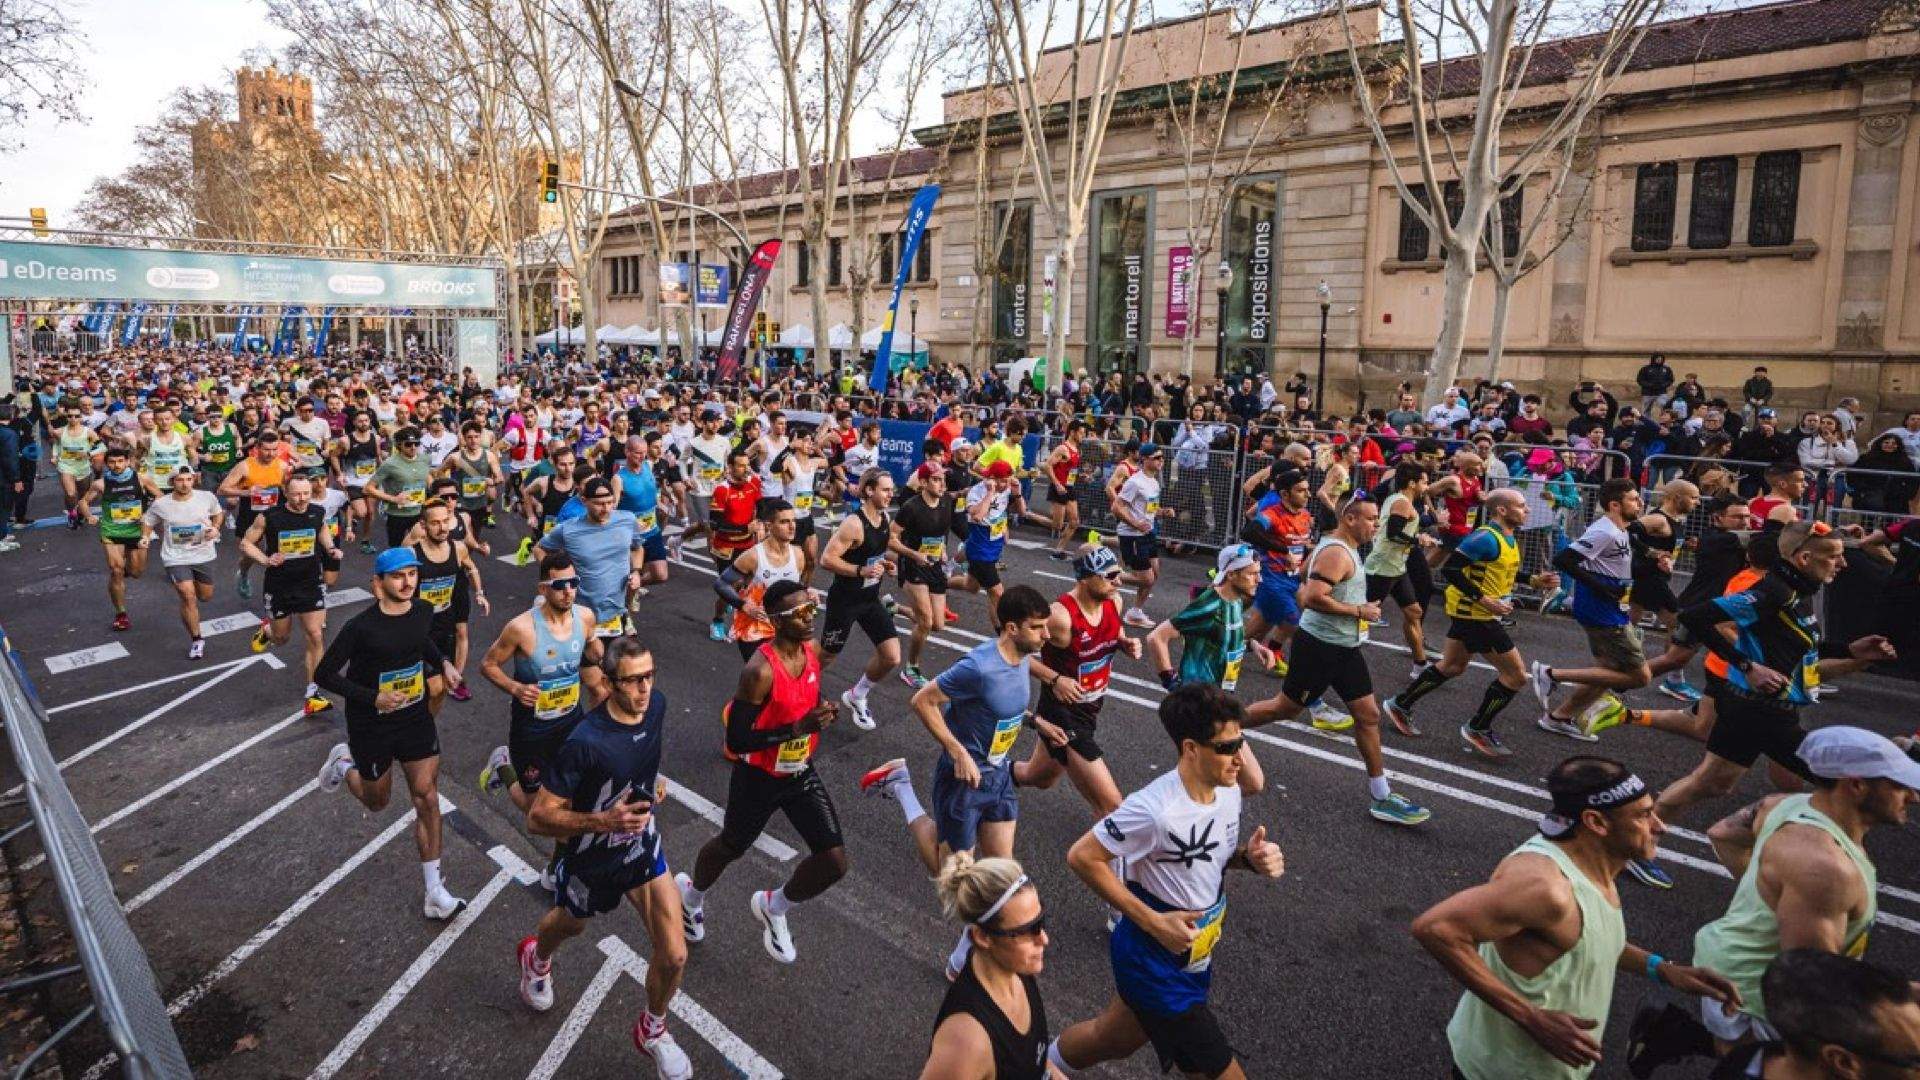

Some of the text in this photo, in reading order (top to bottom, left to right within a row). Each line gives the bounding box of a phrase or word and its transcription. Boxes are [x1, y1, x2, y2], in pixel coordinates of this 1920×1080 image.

[13, 260, 117, 282] eDreams
[407, 280, 476, 296] BROOKS
[1124, 256, 1141, 338] martorell
[1250, 222, 1271, 339] exposicions
[1013, 284, 1026, 337] centre
